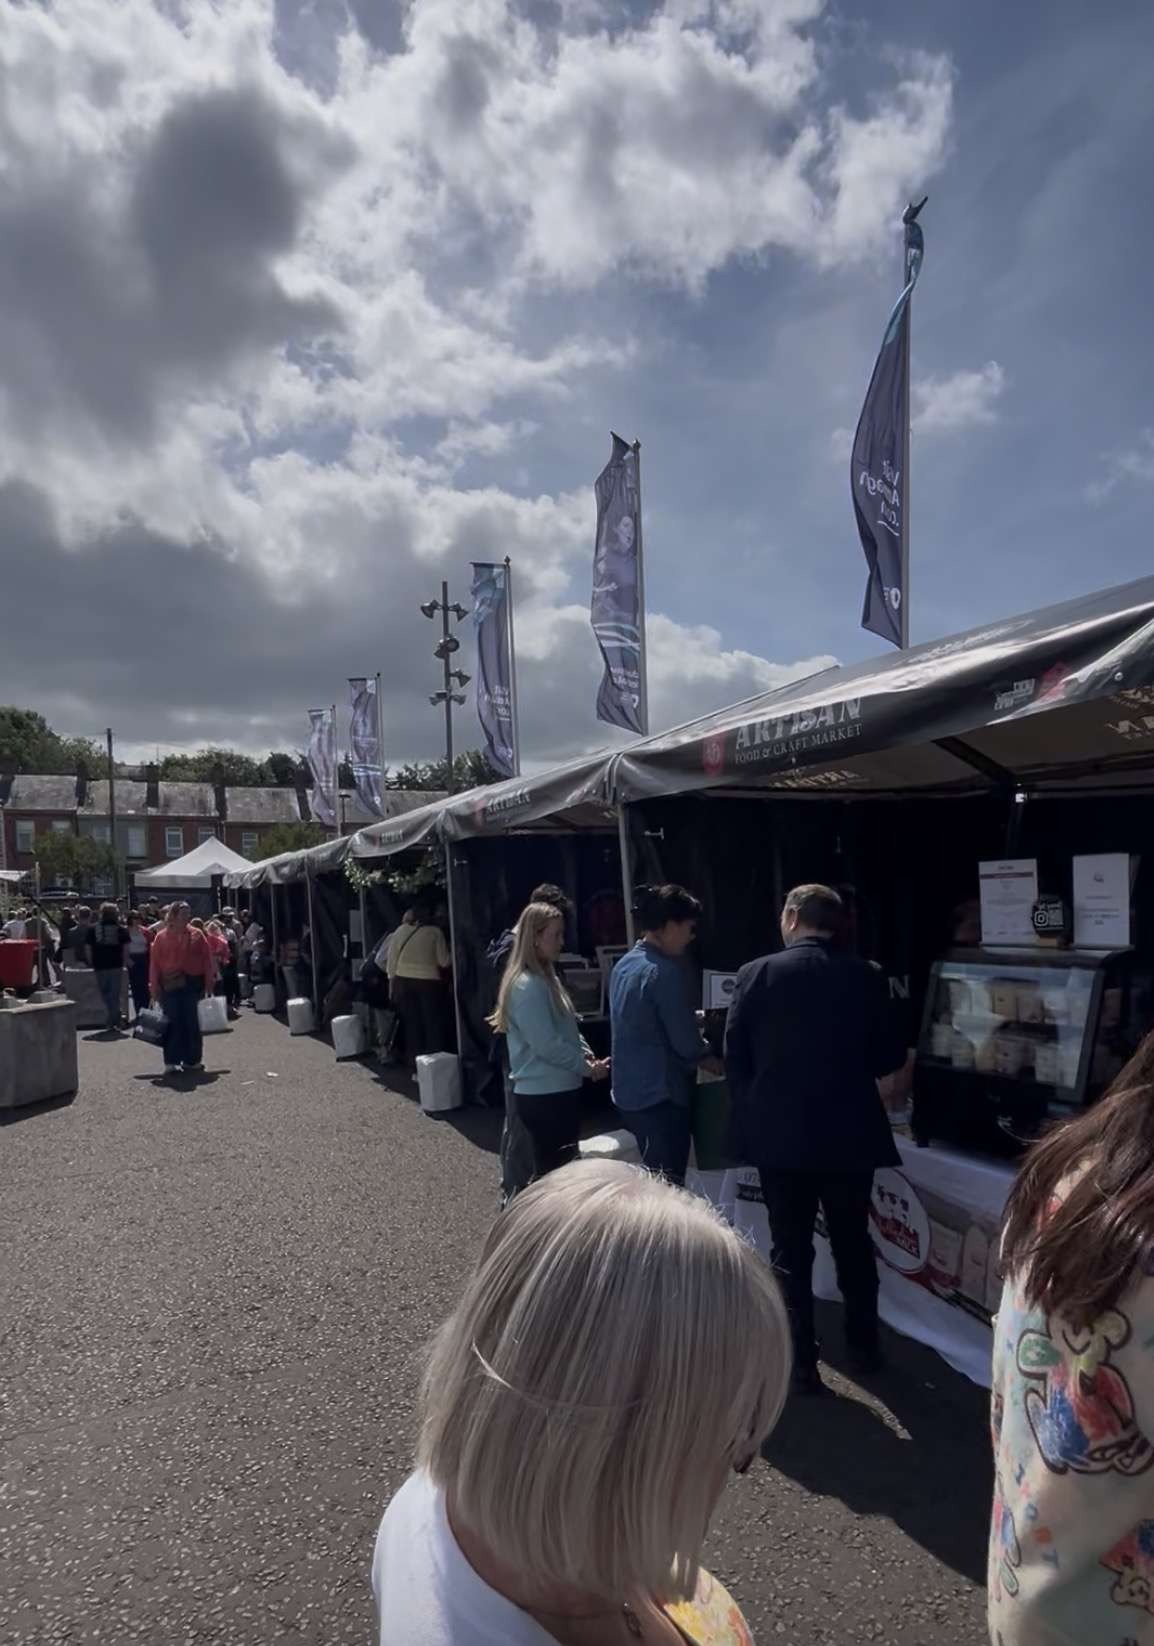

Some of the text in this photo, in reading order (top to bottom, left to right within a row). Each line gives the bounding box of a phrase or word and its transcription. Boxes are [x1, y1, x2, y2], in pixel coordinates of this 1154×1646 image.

[735, 697, 862, 750] ARTISAN
[735, 750, 760, 765] FOOD
[774, 738, 808, 755] CRAFT
[811, 723, 862, 746] MARKET
